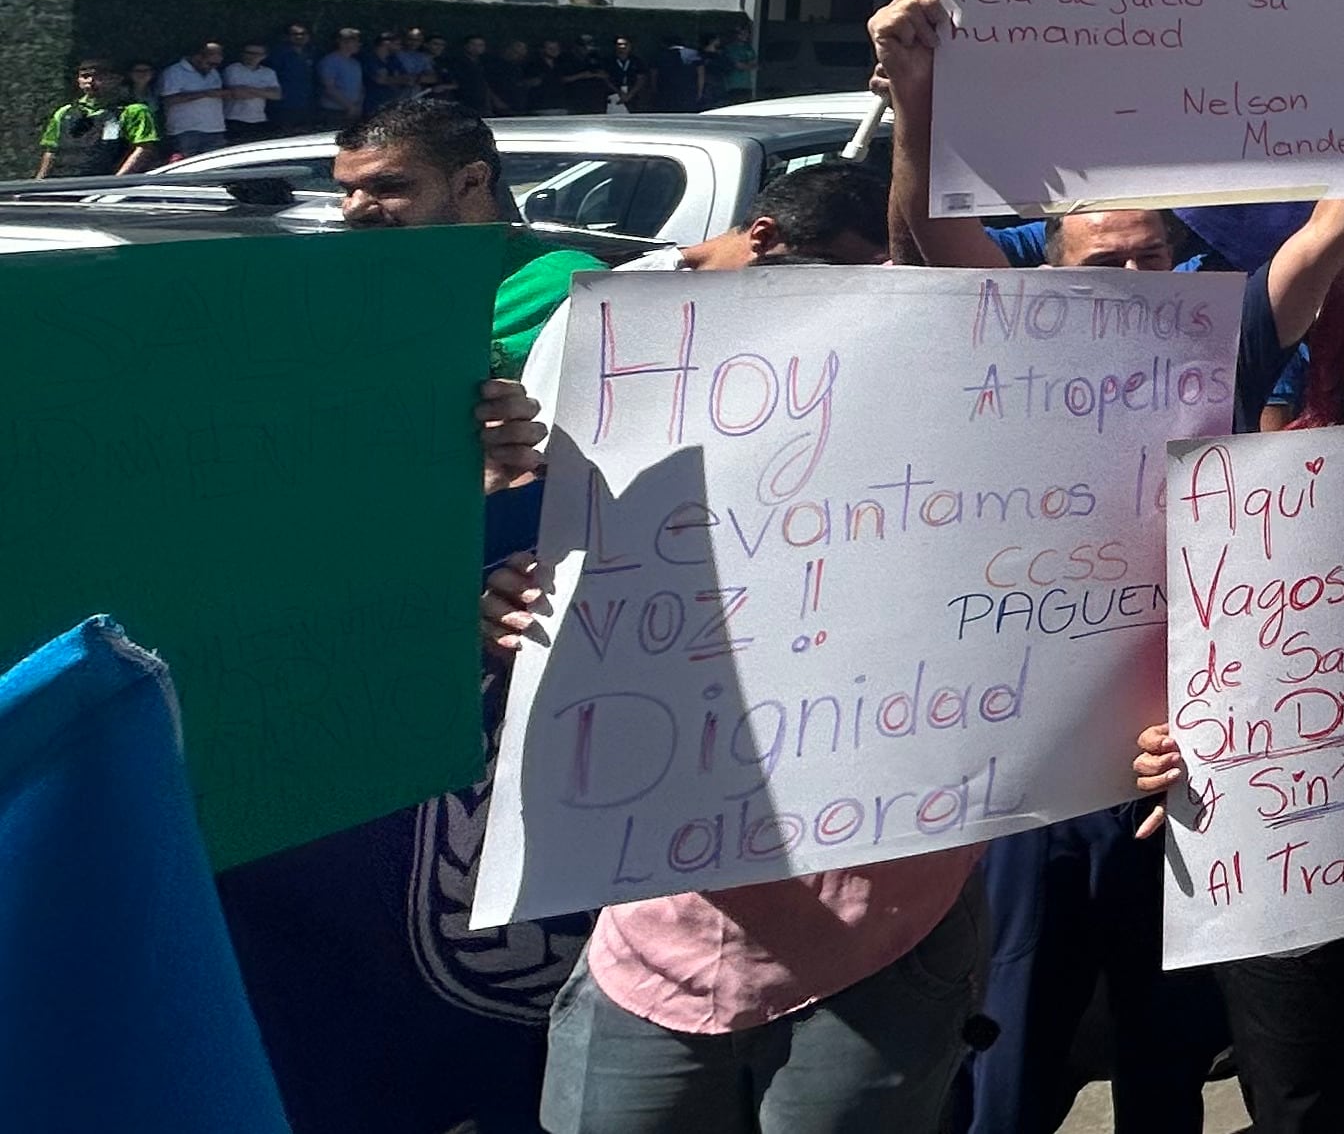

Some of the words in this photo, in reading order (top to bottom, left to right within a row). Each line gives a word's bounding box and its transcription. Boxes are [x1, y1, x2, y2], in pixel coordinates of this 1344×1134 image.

[949, 11, 1184, 50] humanidad
[1184, 81, 1308, 116] Nelson
[972, 277, 1069, 345] No
[593, 300, 841, 506] Hoy
[964, 355, 1231, 435] Atropellos
[581, 462, 1098, 577] Levantamos
[985, 541, 1130, 589] CCSS
[1186, 641, 1242, 698] de
[554, 647, 1031, 810] Dignidad
[1175, 698, 1274, 762] Sin
[1248, 768, 1331, 820] Sin
[1206, 850, 1244, 906] Al
